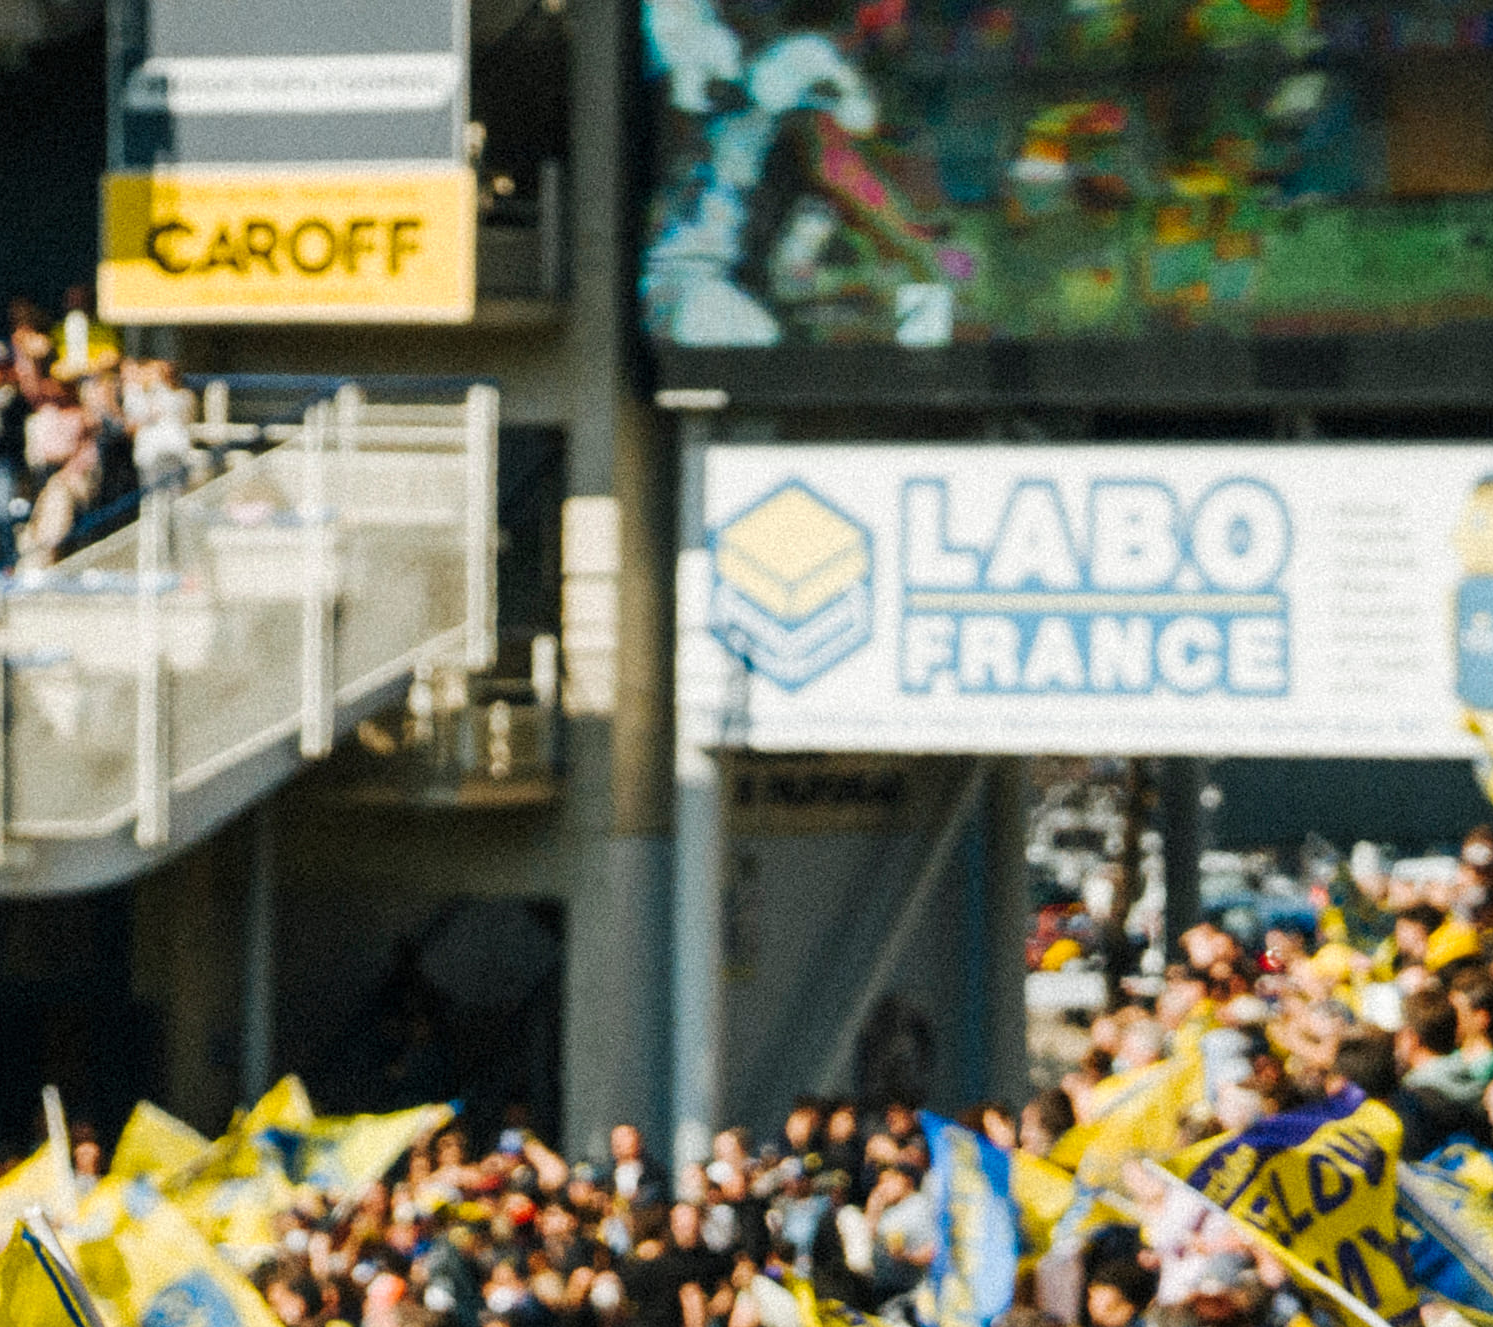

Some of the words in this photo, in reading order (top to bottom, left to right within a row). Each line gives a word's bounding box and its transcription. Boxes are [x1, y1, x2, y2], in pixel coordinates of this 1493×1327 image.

[145, 217, 425, 277] CAROFF
[900, 475, 1295, 594] LABO
[900, 610, 1293, 698] FRANCE
